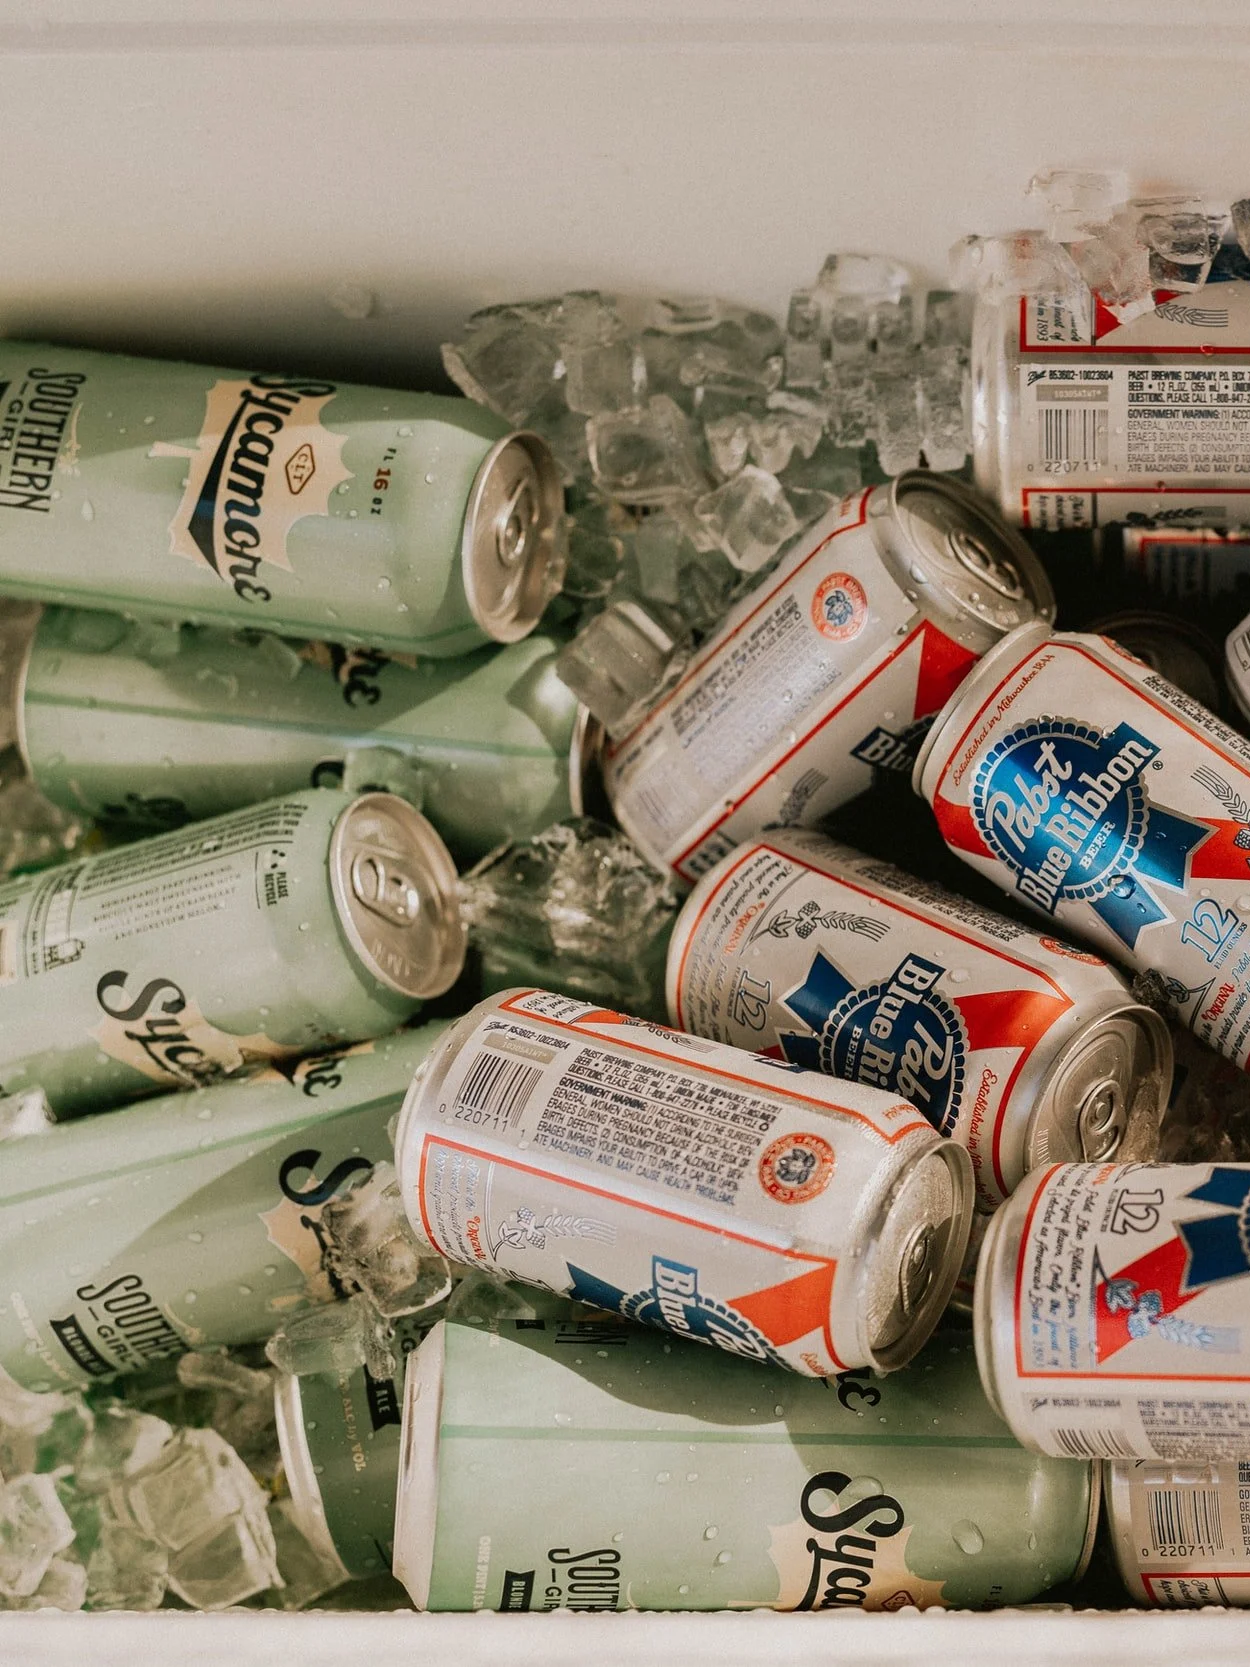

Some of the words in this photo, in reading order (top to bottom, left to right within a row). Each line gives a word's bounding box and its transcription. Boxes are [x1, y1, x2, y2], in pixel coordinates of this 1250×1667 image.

[1128, 370, 1148, 380] PABST
[1127, 409, 1180, 419] GOVERNMENT
[1166, 393, 1190, 402] PLEASE
[0, 367, 87, 512] SOUTHERN
[294, 450, 309, 481] CLT
[373, 467, 391, 490] 16
[189, 374, 337, 604] Sycamore
[954, 727, 989, 786] Established
[996, 670, 1038, 722] Milwaukee
[986, 741, 1073, 853] Pabst
[1043, 738, 1157, 855] Ribbon
[1079, 819, 1117, 870] BEER
[264, 872, 278, 907] RECYCLE
[276, 871, 290, 898] PLEASE
[1026, 838, 1073, 909] Blue
[1180, 897, 1239, 963] 12
[1214, 950, 1230, 970] FLUID
[1228, 922, 1248, 952] OUNCES
[1231, 952, 1250, 982] Pabst
[734, 970, 771, 1031] 12
[869, 958, 940, 1040] Blue
[897, 1019, 954, 1103] Pab
[558, 1076, 612, 1101] GOVERNMENT
[604, 1075, 630, 1090] PLEASE
[628, 1081, 647, 1095] CALL
[967, 1068, 998, 1136] Established
[439, 1103, 447, 1114] 0
[455, 1105, 508, 1133] 220711
[541, 1108, 565, 1124] BIRTH
[590, 1098, 621, 1116] WOMEN
[1113, 1188, 1164, 1235] 12
[1143, 1547, 1151, 1557] 0
[1160, 1544, 1217, 1557] 220711
